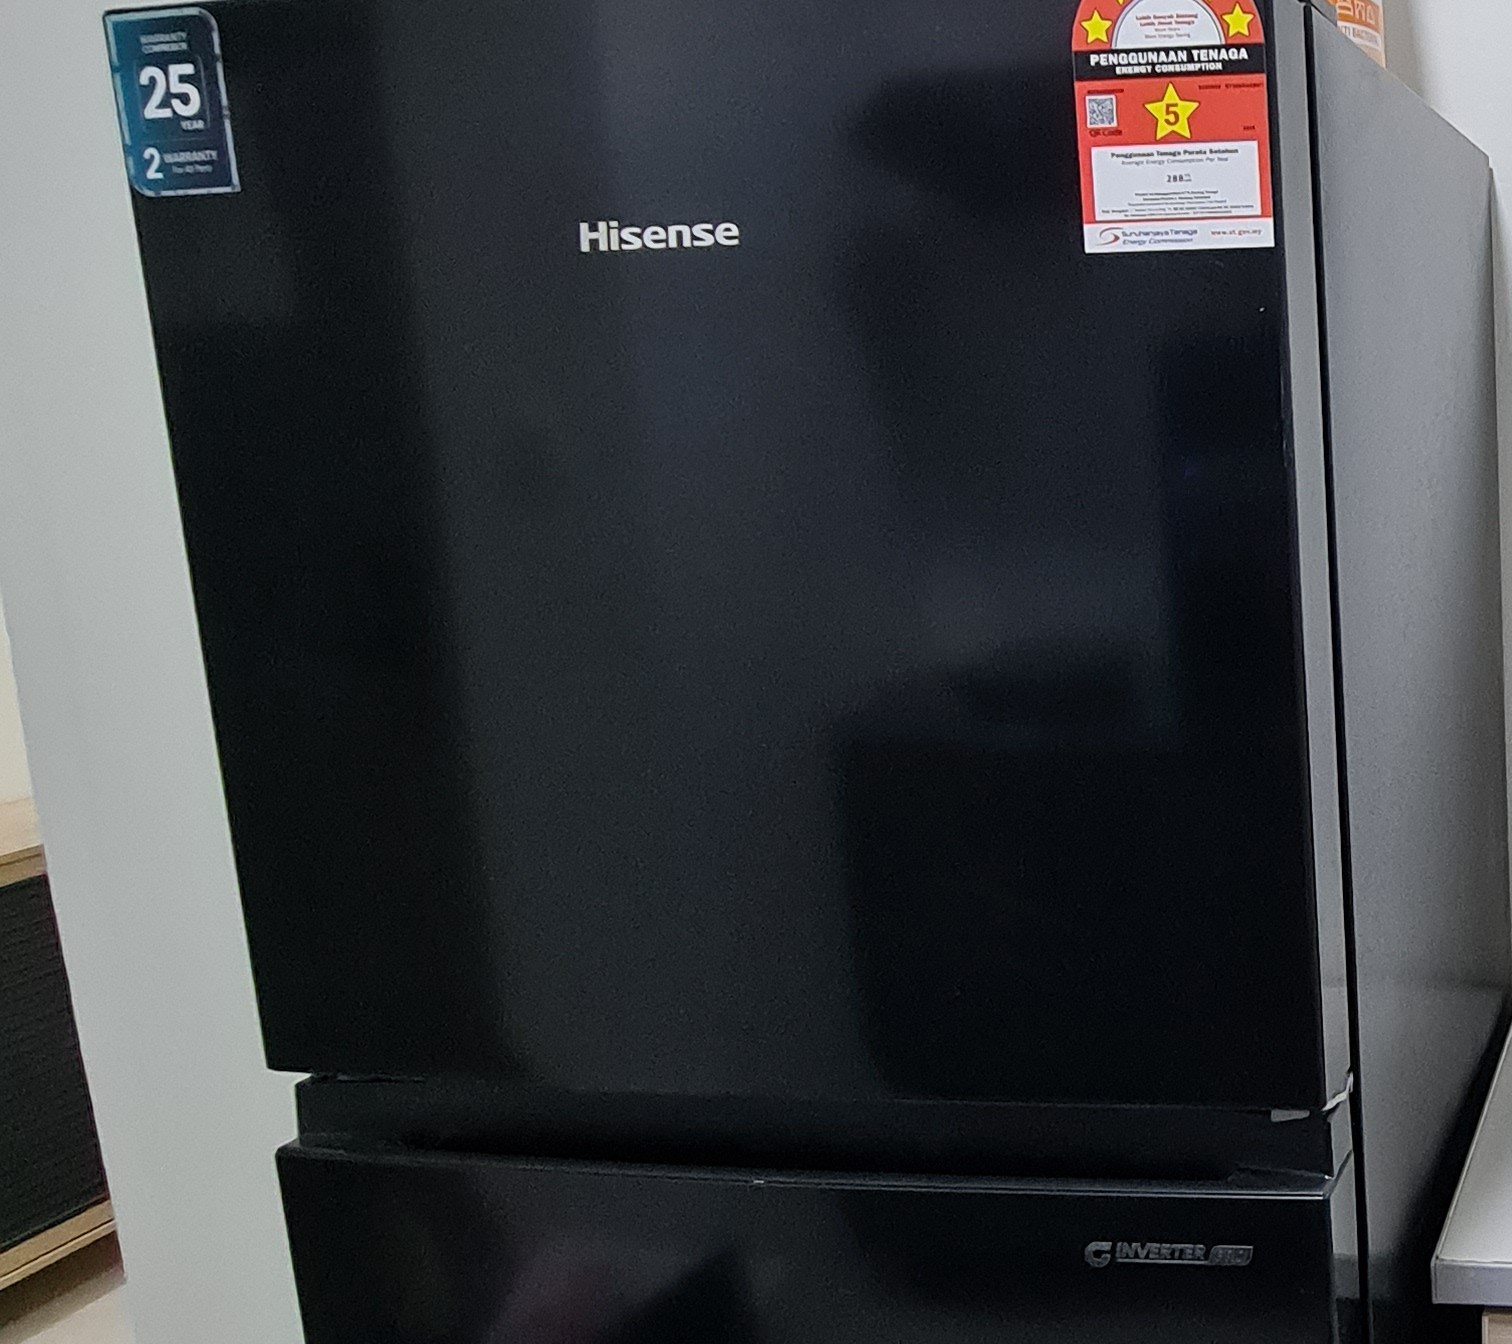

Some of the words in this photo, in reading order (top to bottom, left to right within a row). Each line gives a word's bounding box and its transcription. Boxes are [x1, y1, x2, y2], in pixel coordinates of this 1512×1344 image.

[1090, 50, 1188, 66] PENGGUNAAN
[1191, 47, 1249, 61] TENAGA
[1115, 65, 1152, 75] ENERGY
[1155, 62, 1223, 73] CONSUMPTION
[139, 63, 201, 120] 25
[180, 119, 205, 130] YEAR
[1163, 103, 1180, 126] 5
[143, 147, 164, 180] 2
[579, 220, 740, 253] Hisense
[1115, 1242, 1206, 1260] INVERTER
